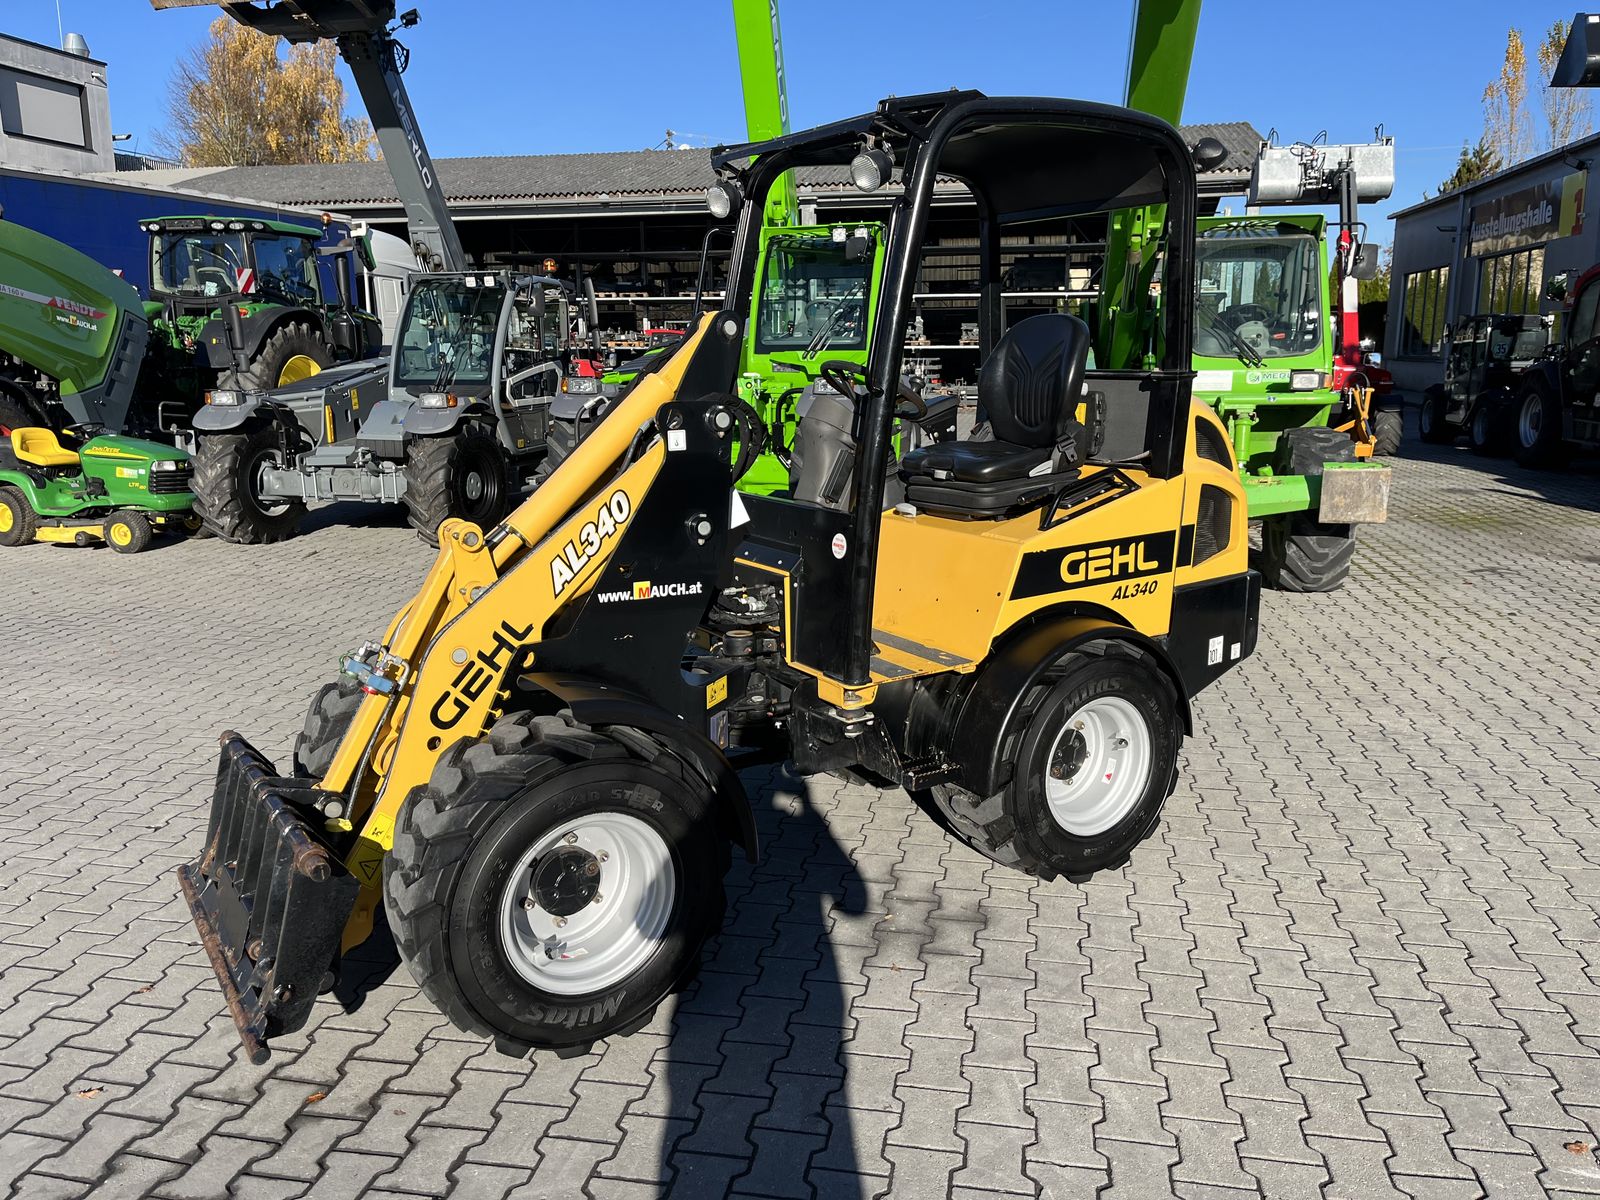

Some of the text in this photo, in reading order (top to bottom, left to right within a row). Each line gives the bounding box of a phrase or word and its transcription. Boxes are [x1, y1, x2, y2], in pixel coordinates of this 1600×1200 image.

[393, 88, 432, 190] MERLO
[1470, 188, 1584, 241] Ausstellungshalle 1
[55, 296, 97, 317] FENDT
[56, 315, 97, 331] www.MAUCH.at
[1496, 343, 1508, 354] 35
[550, 490, 631, 599] AL340
[1060, 541, 1159, 584] GEHL
[597, 580, 703, 603] www.MAUCH.at
[1111, 580, 1158, 601] AL340
[430, 620, 534, 730] GEHL
[610, 788, 664, 813] STEER
[525, 990, 627, 1031] Mitas
